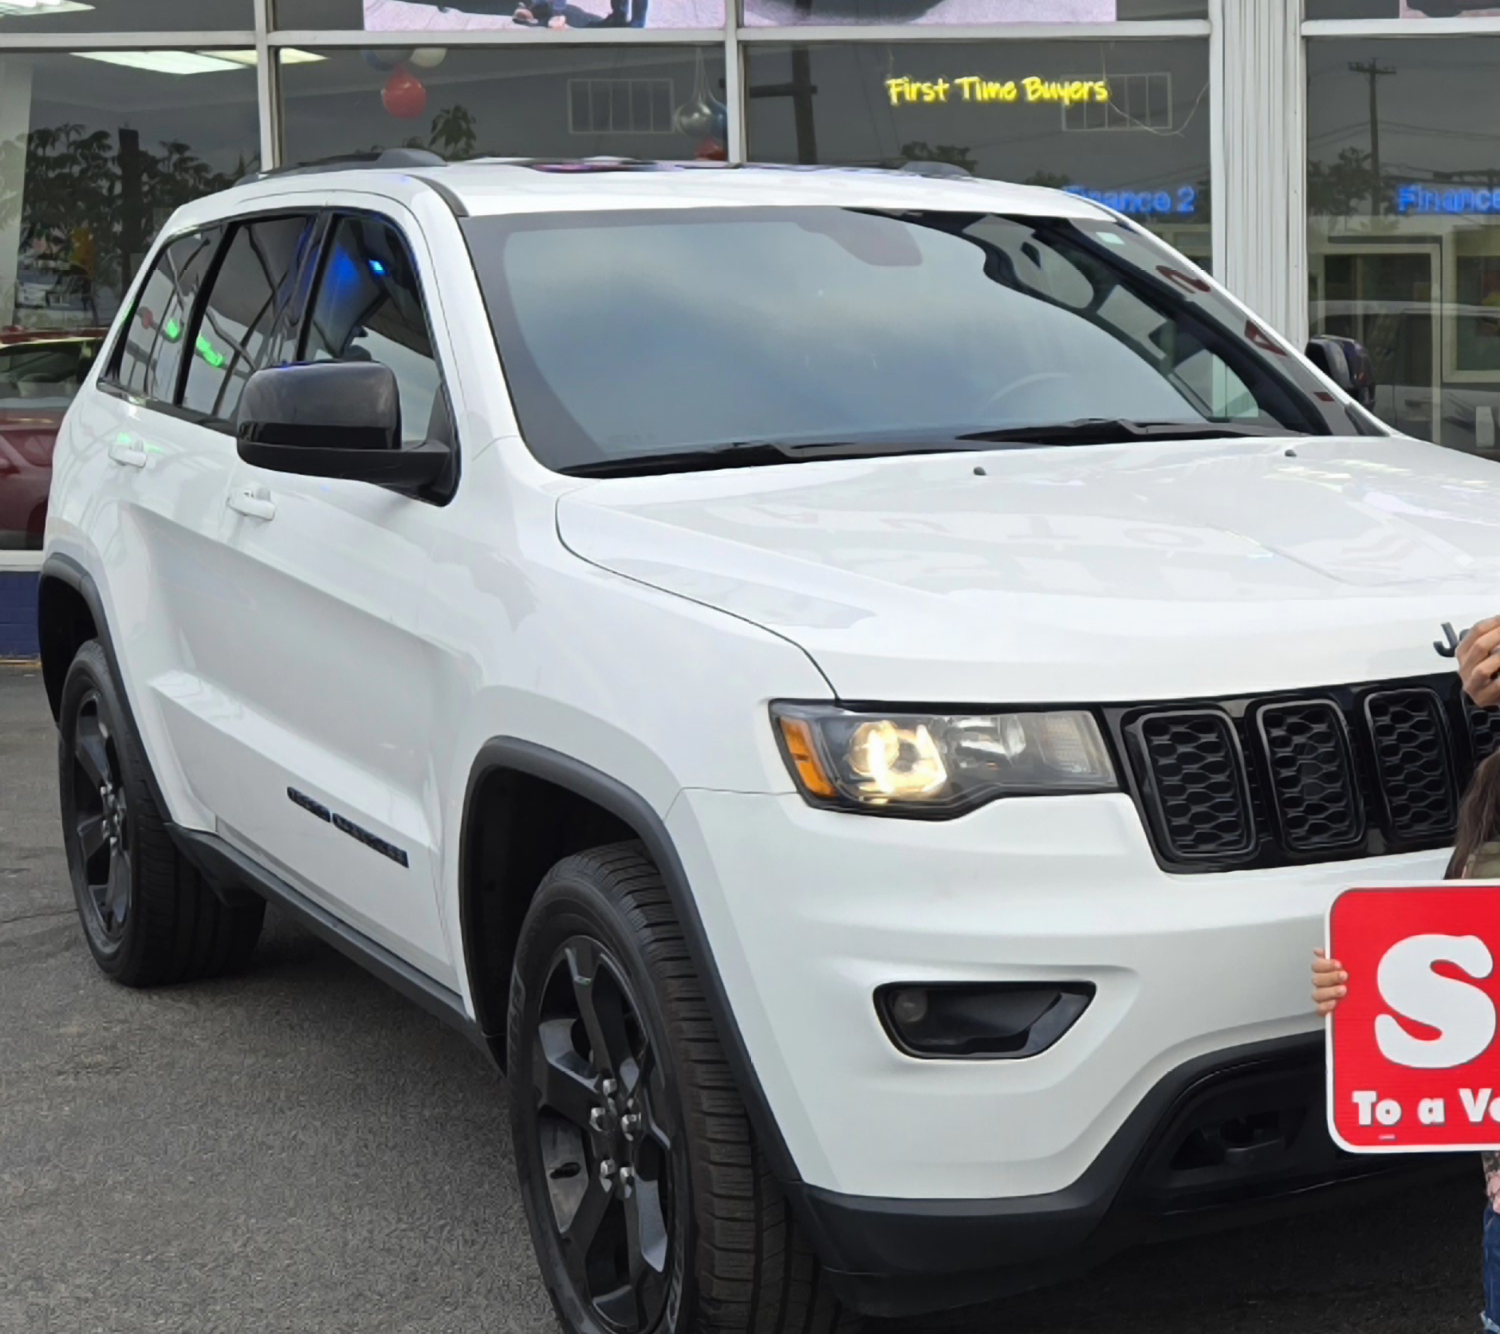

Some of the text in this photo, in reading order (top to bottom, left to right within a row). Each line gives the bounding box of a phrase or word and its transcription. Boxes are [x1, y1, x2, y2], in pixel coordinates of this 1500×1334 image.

[886, 76, 1109, 108] First Time Buyers
[1063, 185, 1196, 214] nance 2
[1352, 1091, 1402, 1126] To
[1418, 1097, 1445, 1124] a
